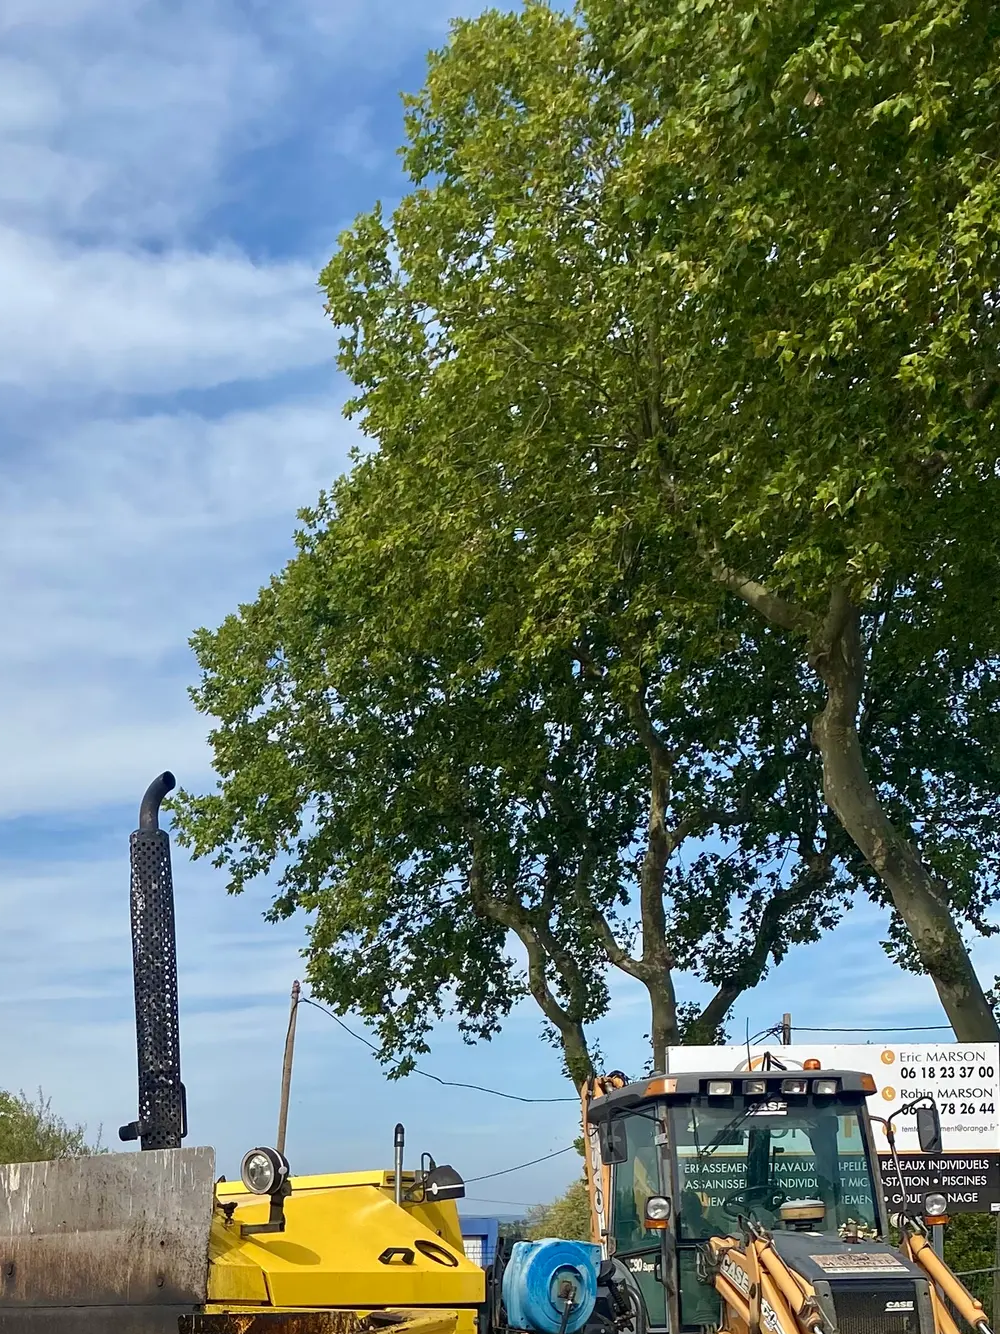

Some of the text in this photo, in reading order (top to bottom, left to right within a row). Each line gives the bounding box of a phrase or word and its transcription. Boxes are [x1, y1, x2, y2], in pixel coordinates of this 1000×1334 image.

[900, 1051, 985, 1062] Eric MARSON
[900, 1066, 994, 1079] 06 18 23 37 00
[900, 1088, 993, 1099] Robin MARSON
[940, 1103, 955, 1115] 78
[960, 1103, 975, 1115] 26
[979, 1103, 995, 1115] 44
[768, 1162, 815, 1172] TRAVAUX
[929, 1159, 989, 1170] INDIVIDUELS
[942, 1175, 987, 1187] PISCINES
[721, 1254, 750, 1293] CASE
